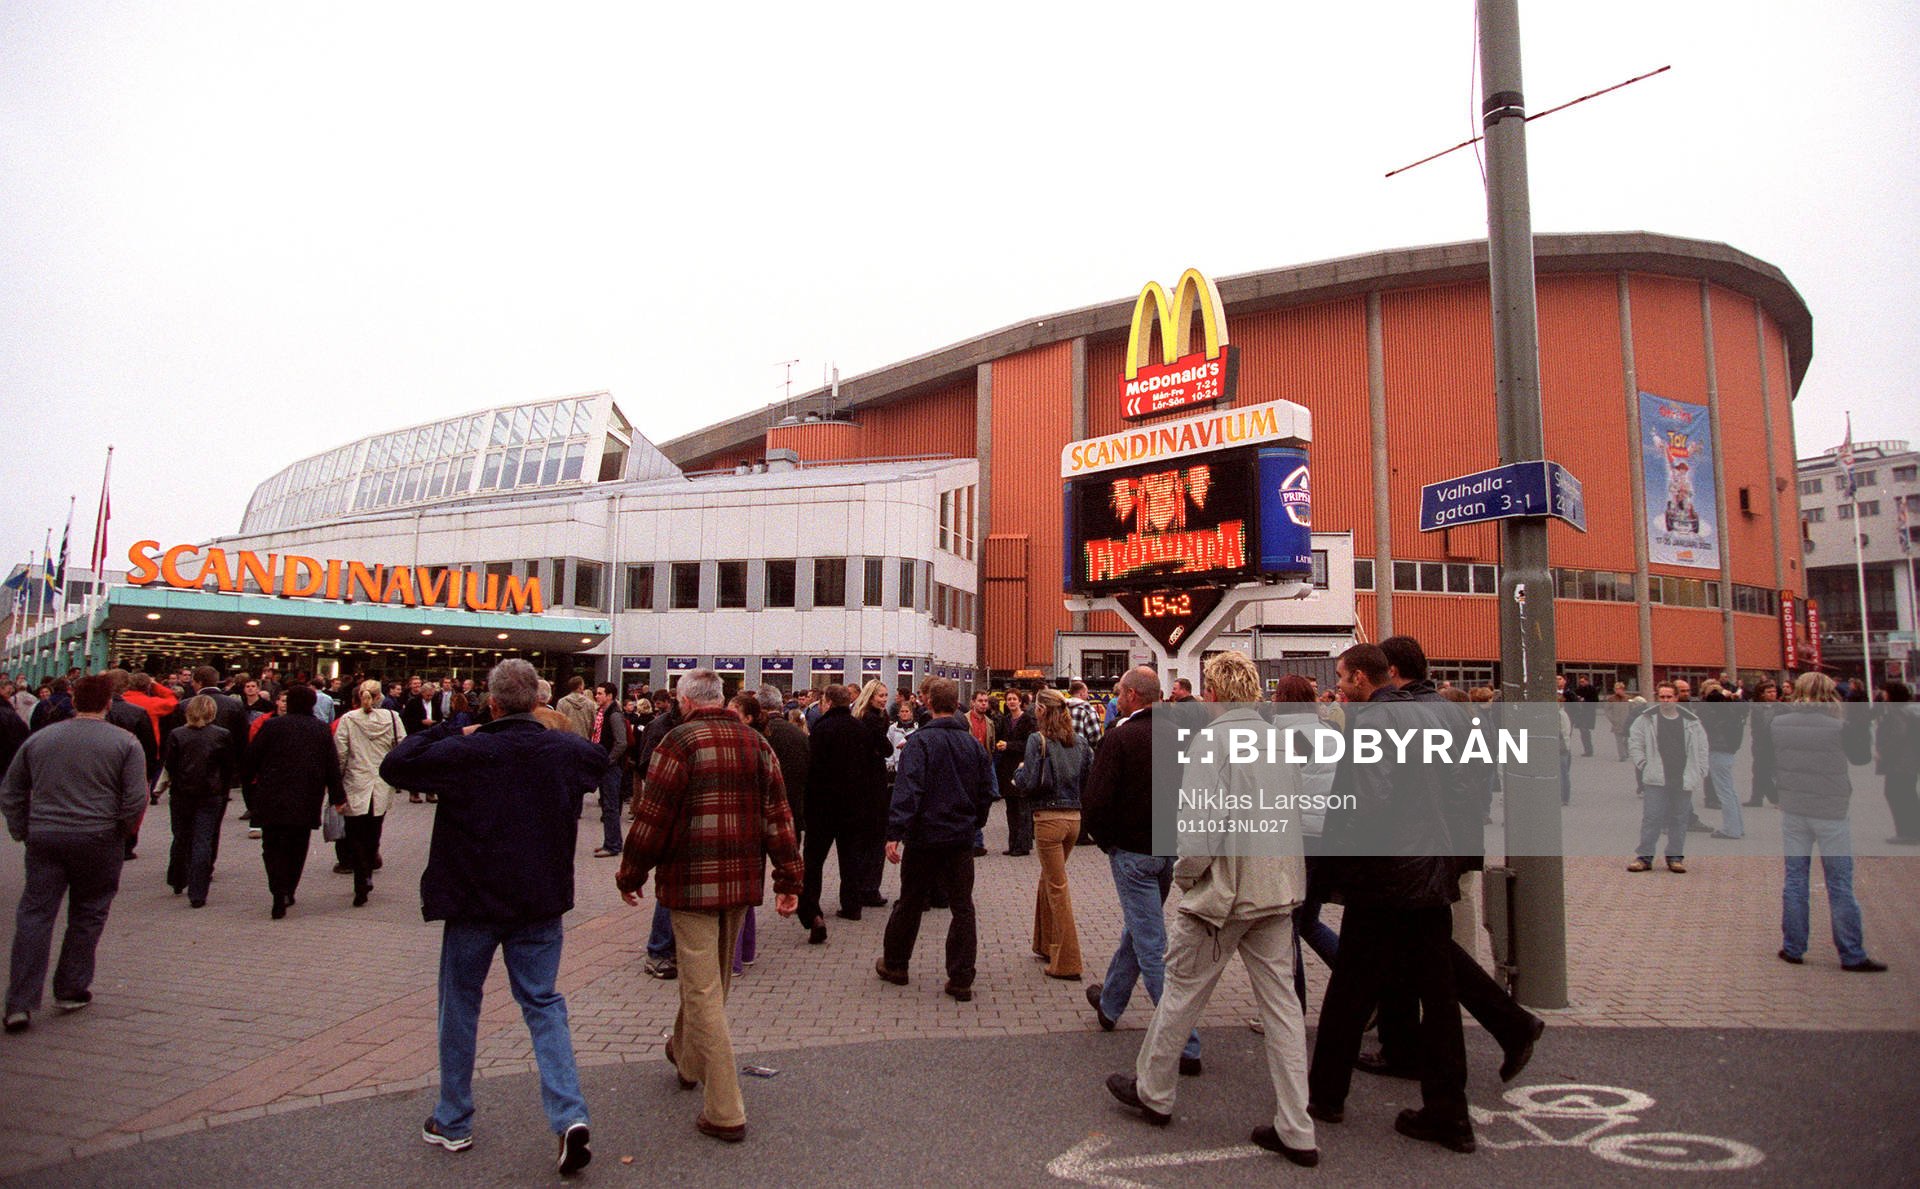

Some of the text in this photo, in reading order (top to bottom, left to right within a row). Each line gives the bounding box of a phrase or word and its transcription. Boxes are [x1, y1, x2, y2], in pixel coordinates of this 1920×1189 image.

[1126, 363, 1219, 396] McDonald's
[1152, 378, 1217, 401] Mån-Fre 7-24
[1152, 388, 1218, 410] Lör-Sön 10-24
[1071, 407, 1279, 471] SCANDINAVIUM
[1437, 477, 1512, 502] Valhalla-
[1435, 494, 1530, 525] gatan 3-1
[127, 540, 544, 614] SCANDINAVIUM
